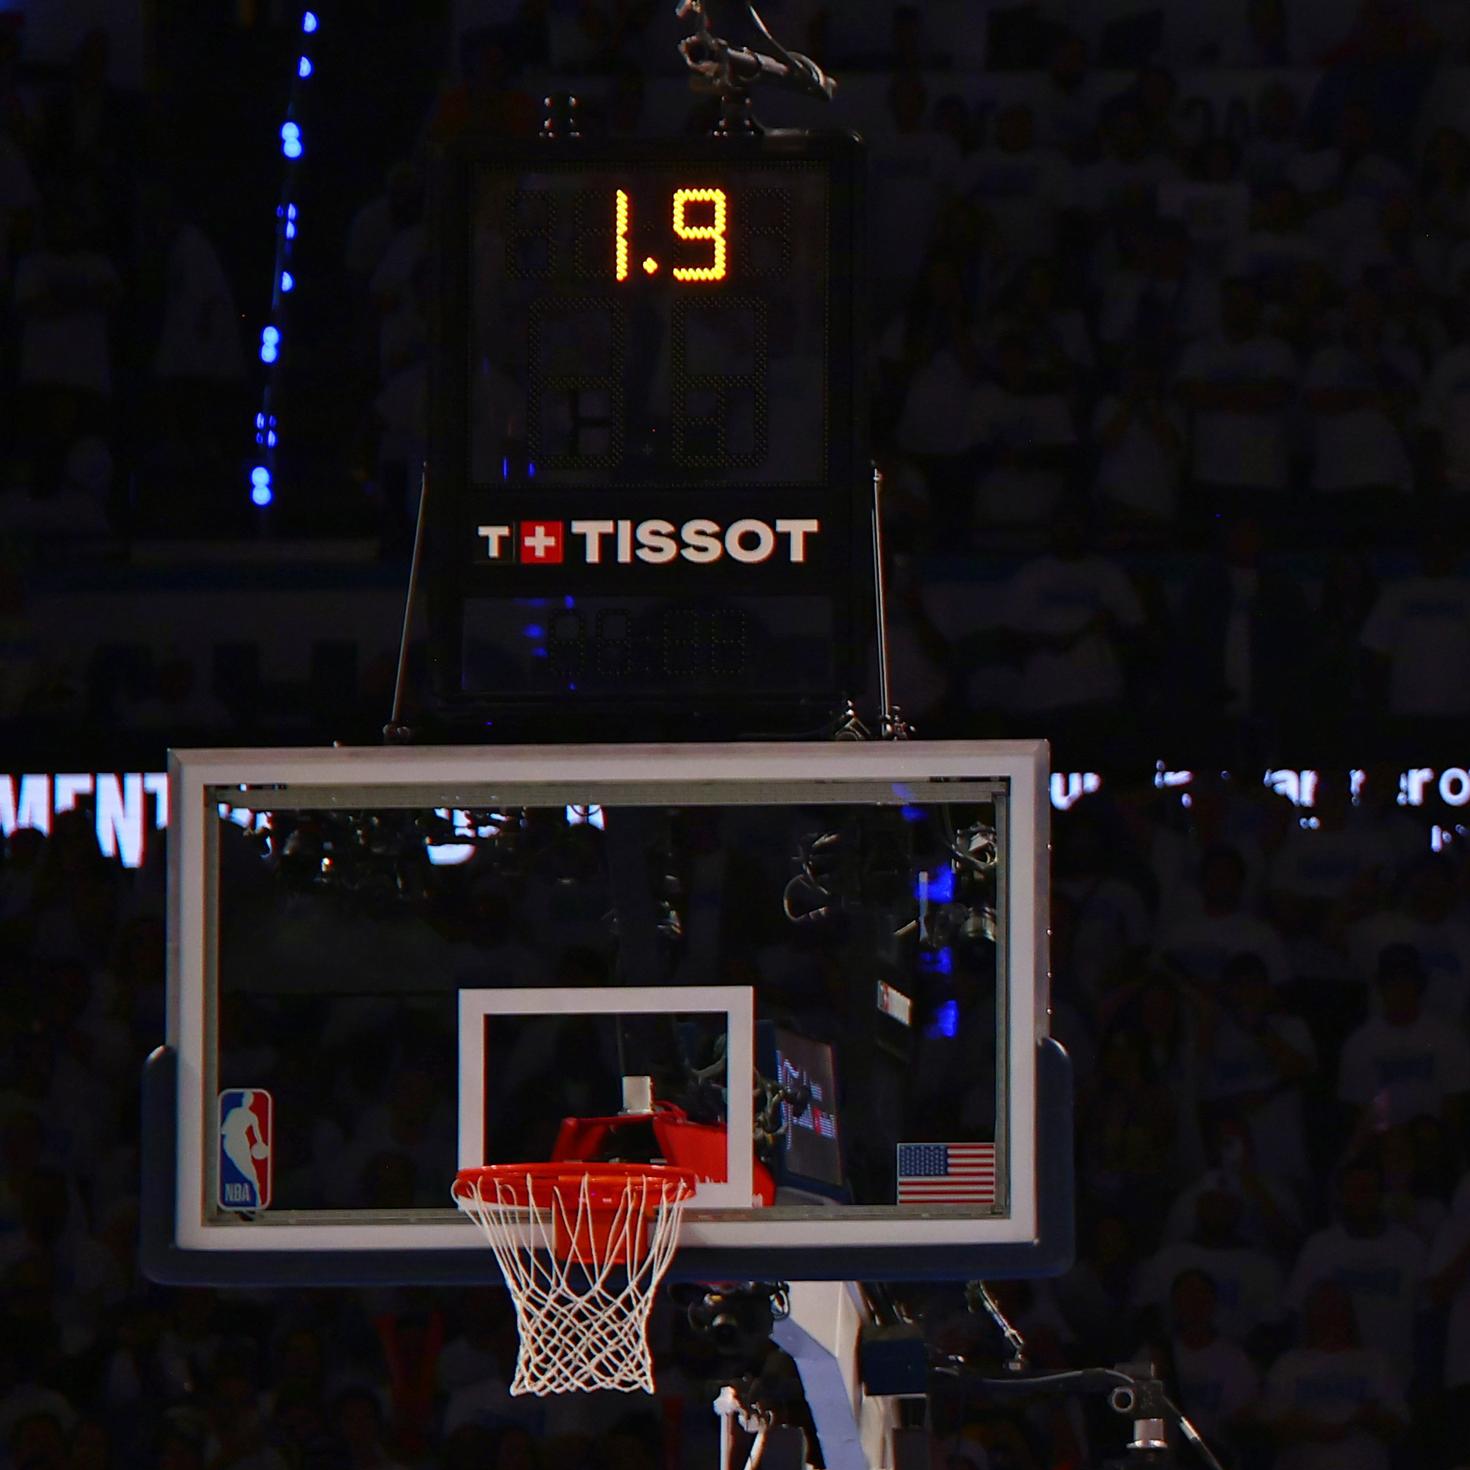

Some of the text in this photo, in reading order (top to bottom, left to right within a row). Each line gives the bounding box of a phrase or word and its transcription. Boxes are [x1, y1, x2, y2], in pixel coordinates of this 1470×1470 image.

[616, 188, 727, 282] 1.9
[571, 518, 819, 564] TISSOT
[225, 1183, 251, 1202] NBA
